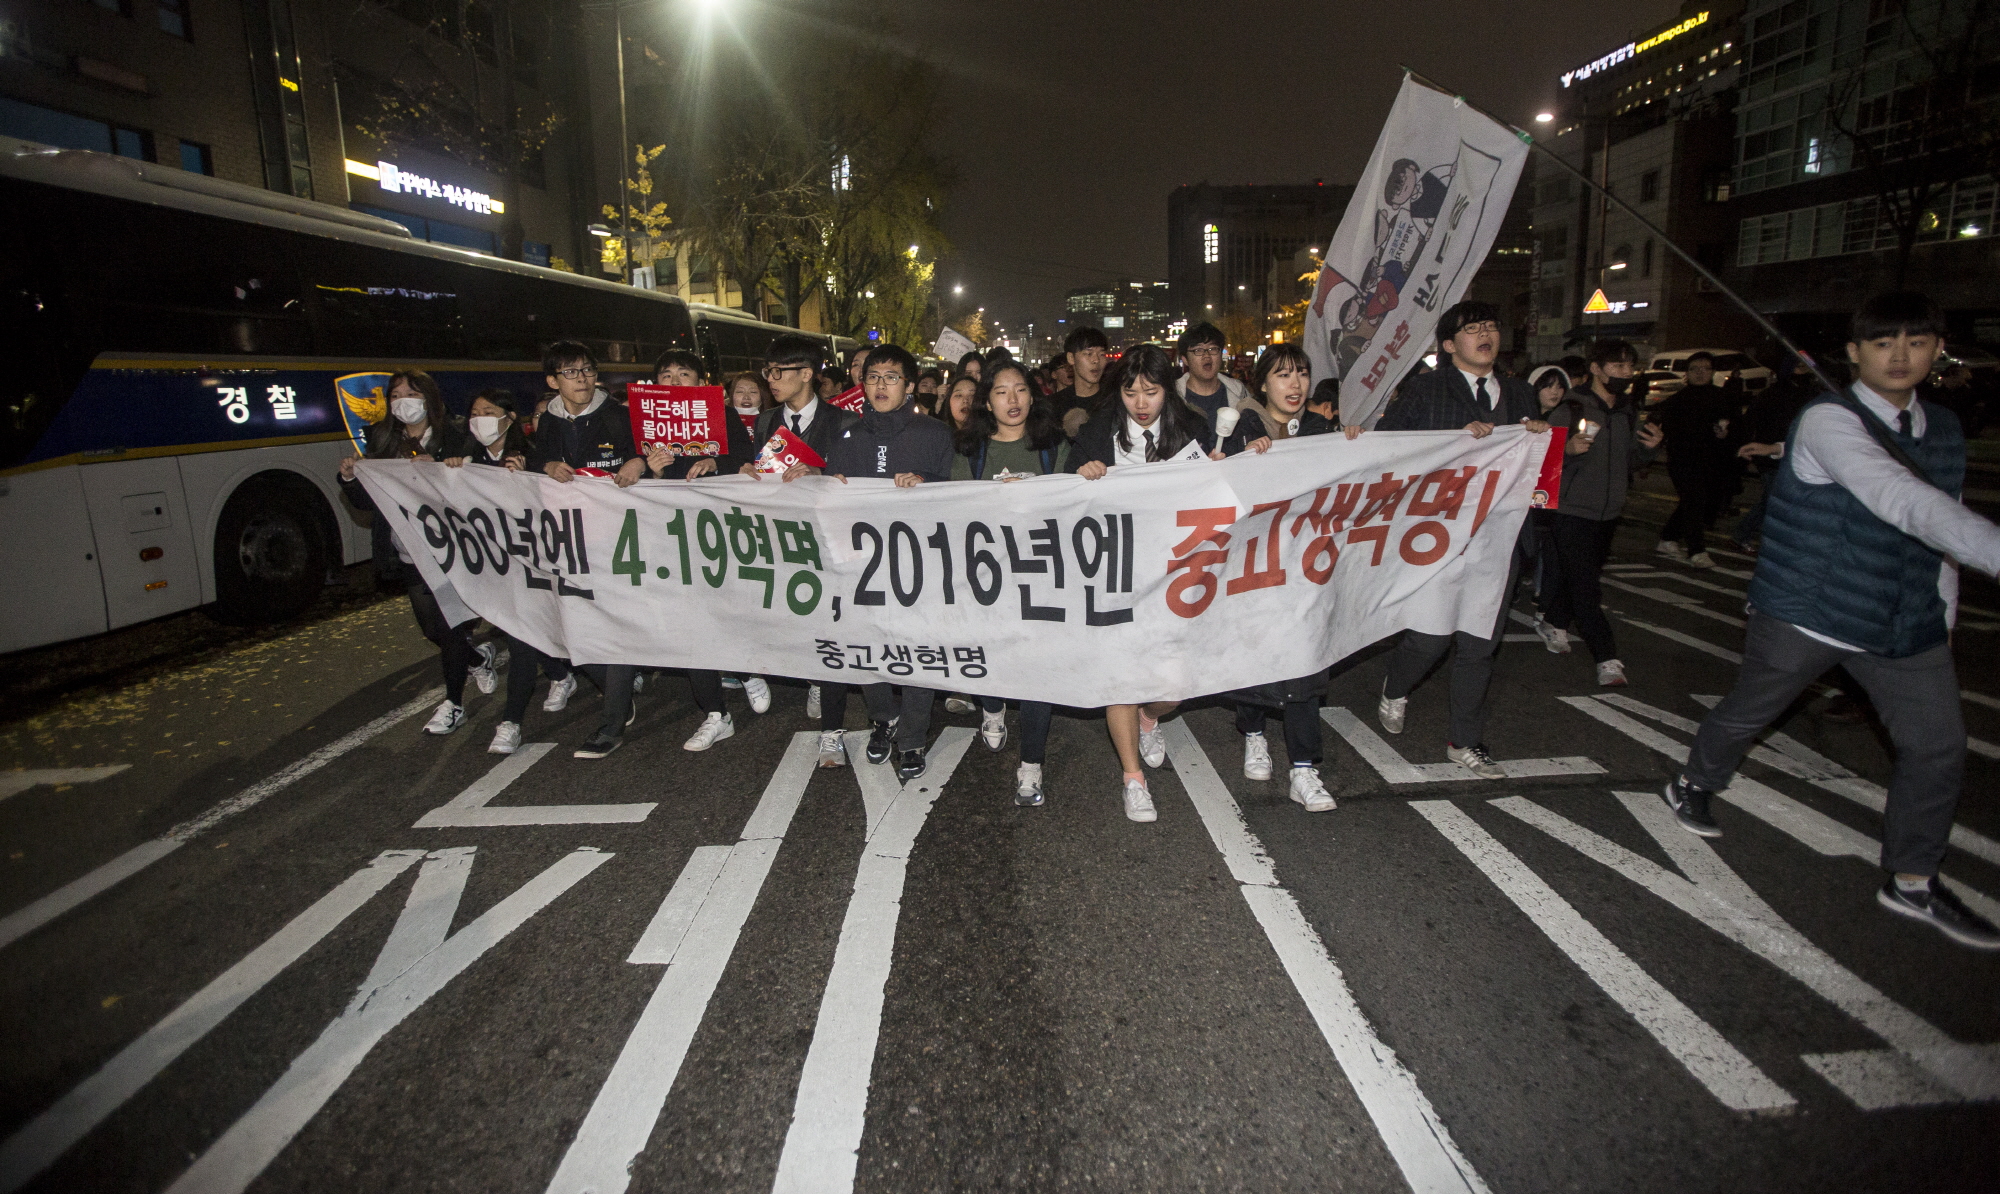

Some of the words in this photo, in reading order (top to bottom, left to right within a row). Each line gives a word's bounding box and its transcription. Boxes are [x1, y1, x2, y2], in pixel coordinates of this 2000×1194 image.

[1574, 42, 1635, 81] 서울지방경찰청
[1635, 11, 1710, 54] www.smpa.go.kr
[217, 384, 298, 424] 경찰
[641, 398, 709, 419] 박근혜를
[642, 420, 711, 440] 몰아내자
[399, 503, 595, 600] 960년엔
[814, 638, 988, 679] 중고생혁명
